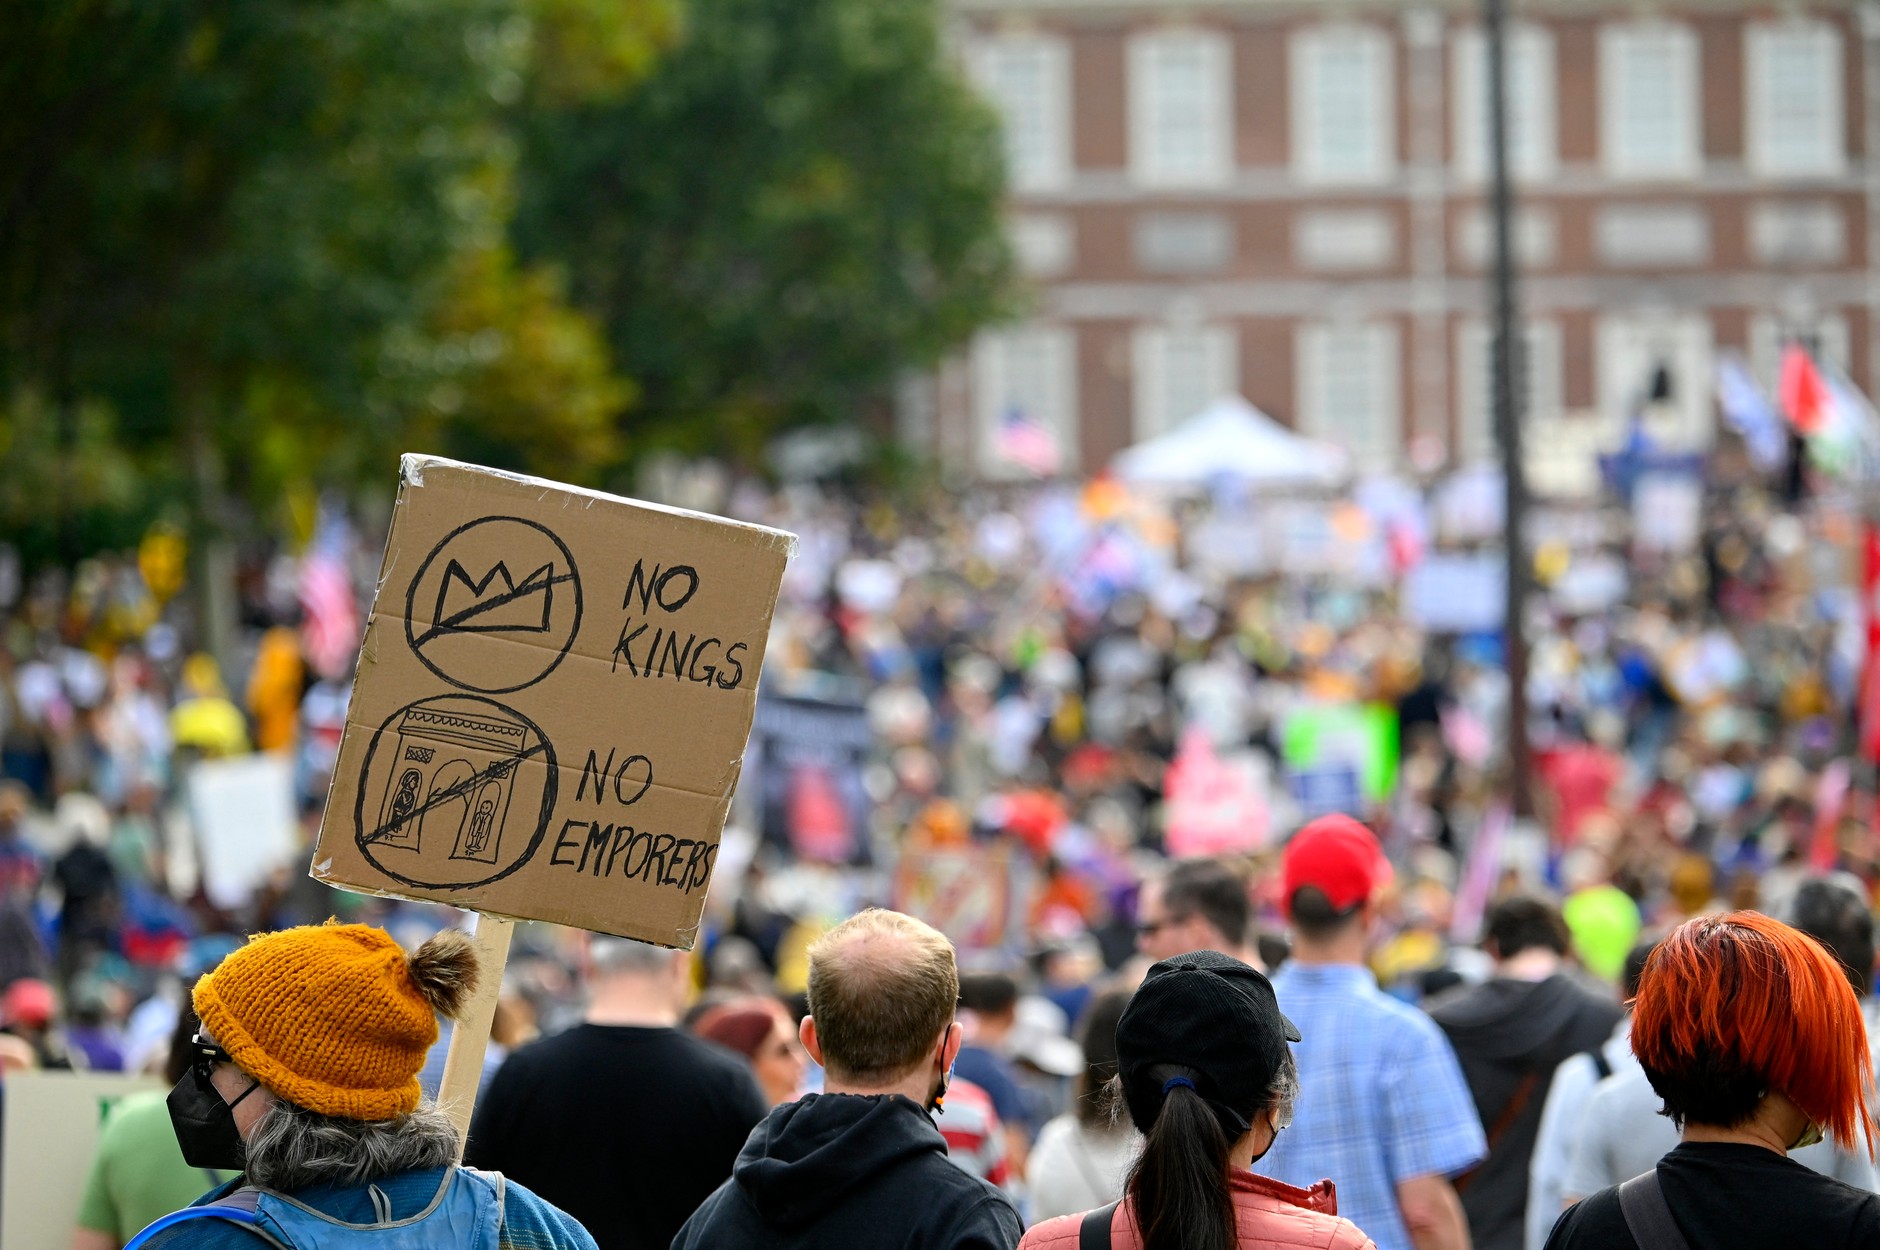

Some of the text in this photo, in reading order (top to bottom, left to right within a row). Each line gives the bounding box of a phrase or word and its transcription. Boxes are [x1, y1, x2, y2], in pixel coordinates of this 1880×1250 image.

[622, 558, 699, 615] NO
[612, 617, 747, 689] KINGS
[575, 747, 653, 805] NO
[550, 818, 718, 895] EMPORERS
